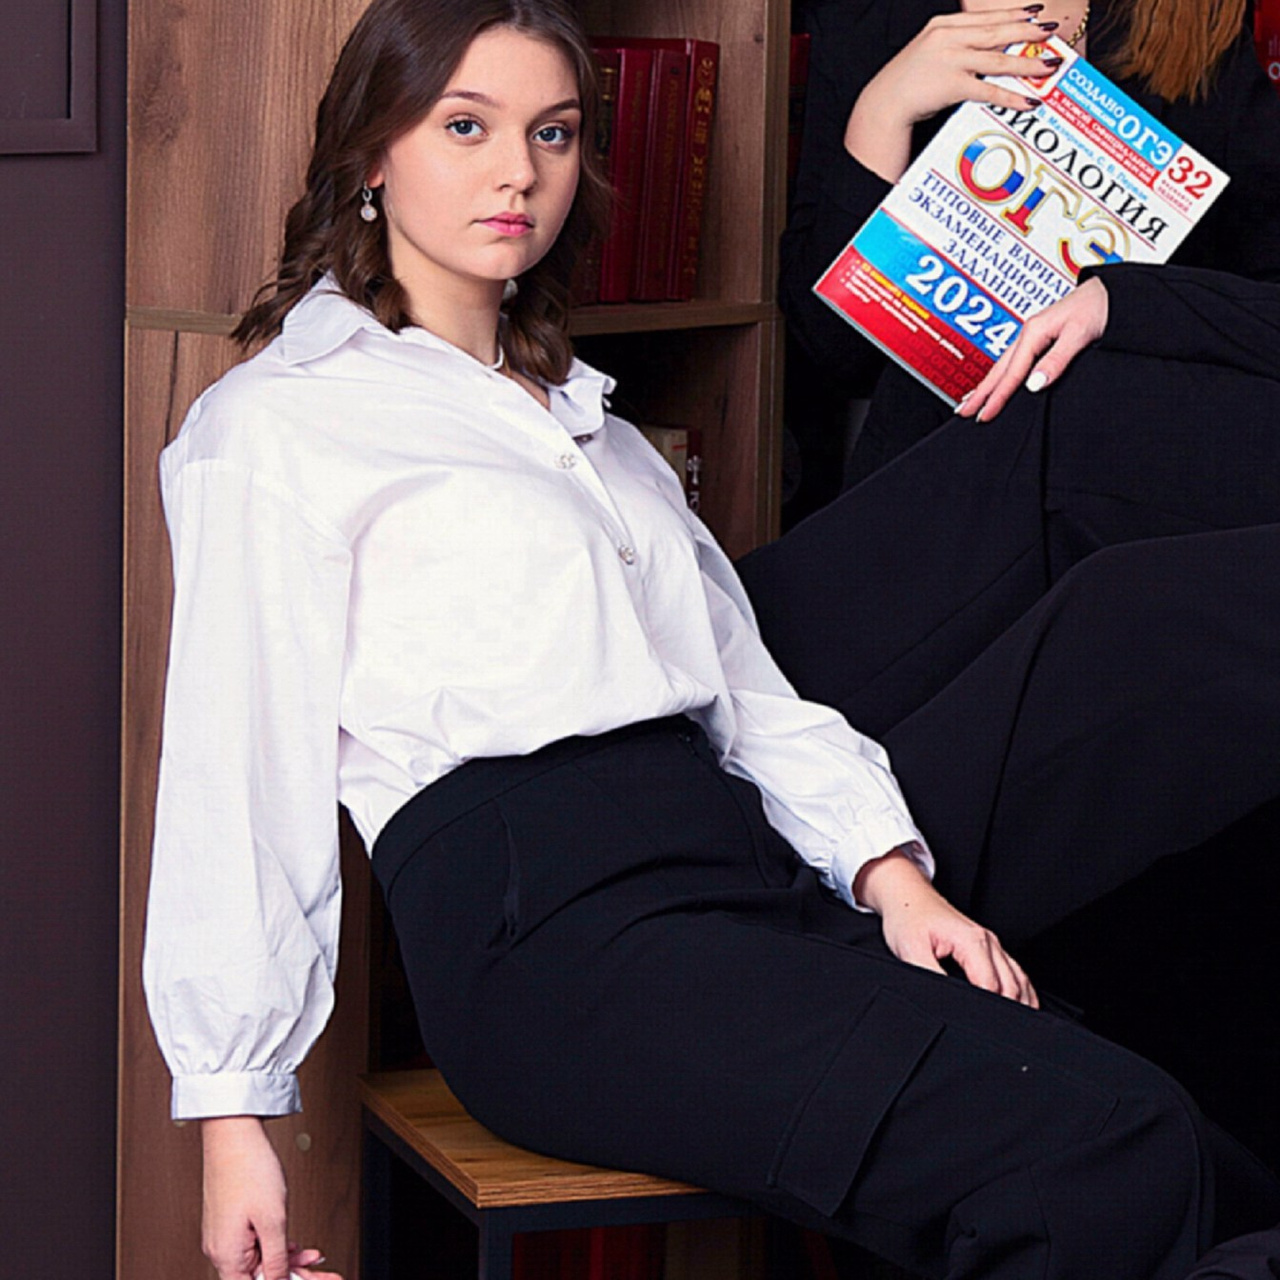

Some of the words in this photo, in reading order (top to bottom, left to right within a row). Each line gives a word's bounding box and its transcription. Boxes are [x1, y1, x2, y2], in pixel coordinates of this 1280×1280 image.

[1067, 67, 1125, 118] СОЗДАНО
[1116, 114, 1173, 165] ОГЭ
[922, 172, 1002, 244] ТИПОВЫЕ
[957, 140, 1129, 290] ОГЭ
[1167, 155, 1213, 200] 32
[904, 254, 1018, 356] 2024
[945, 239, 1032, 315] ЗАДАНИЙ
